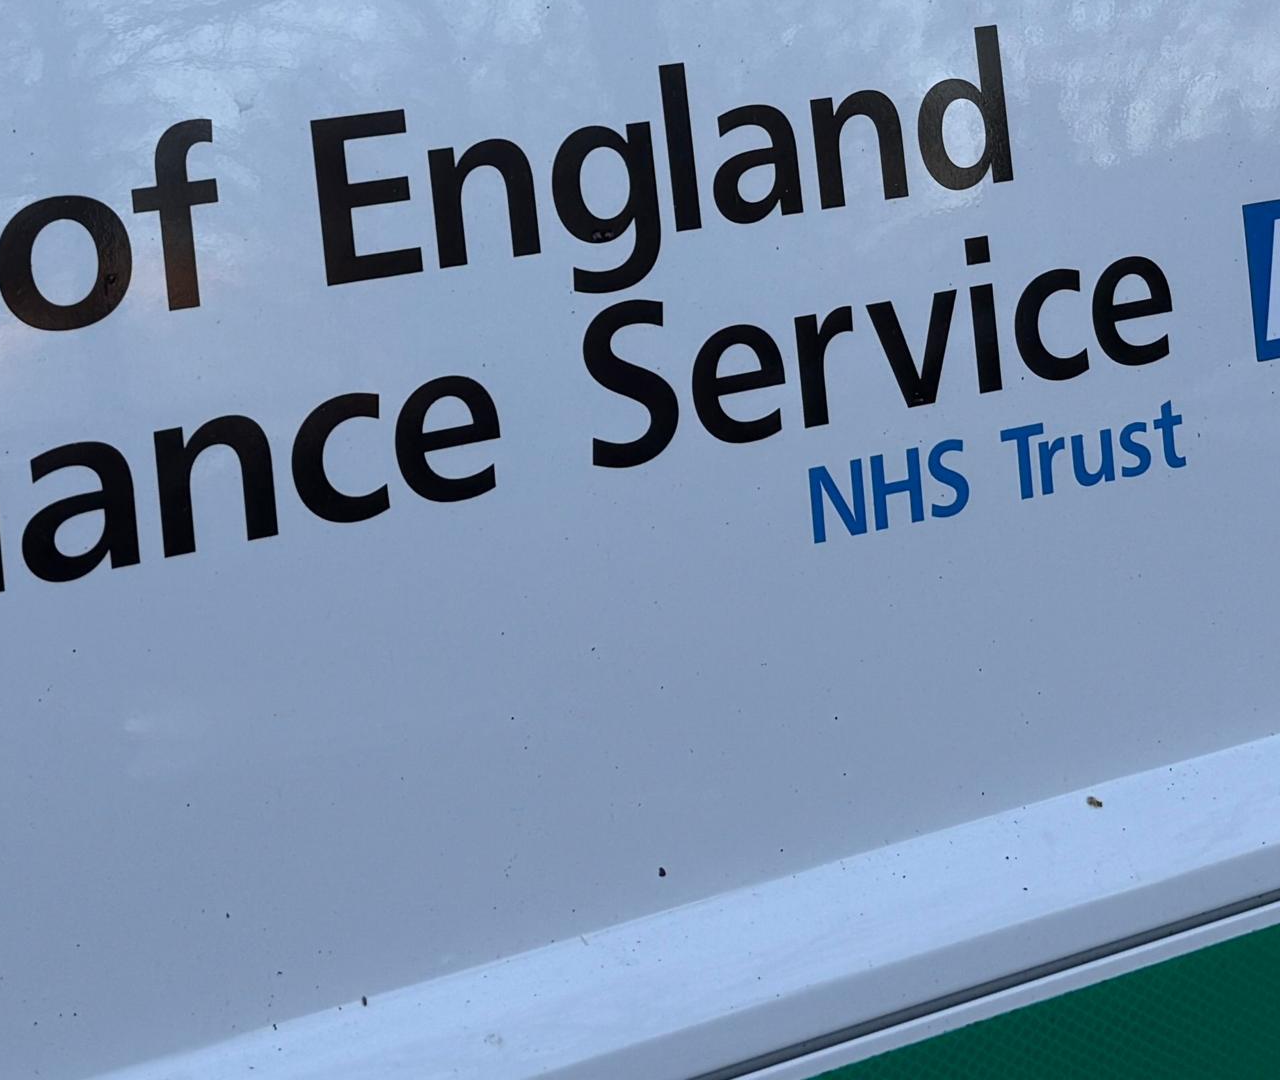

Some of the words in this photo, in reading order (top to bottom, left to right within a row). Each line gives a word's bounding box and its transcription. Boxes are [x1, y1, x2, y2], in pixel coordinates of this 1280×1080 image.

[310, 24, 1014, 294] England
[582, 235, 1173, 469] Service
[809, 439, 971, 544] NHS
[1000, 402, 1186, 500] Trust
